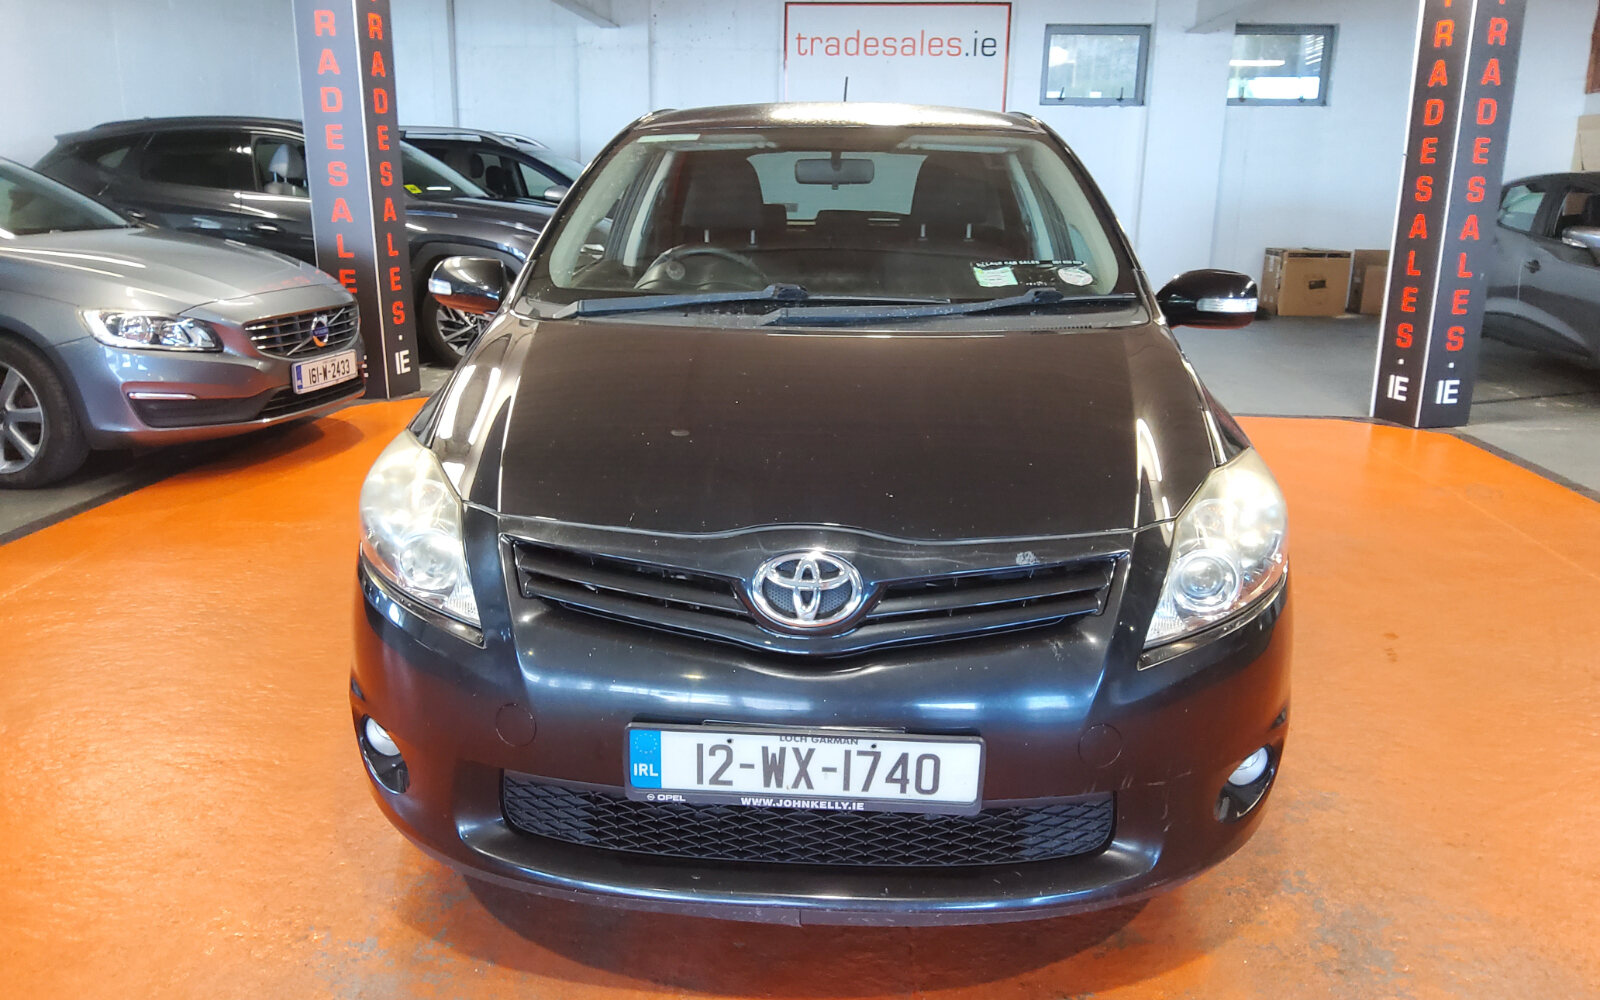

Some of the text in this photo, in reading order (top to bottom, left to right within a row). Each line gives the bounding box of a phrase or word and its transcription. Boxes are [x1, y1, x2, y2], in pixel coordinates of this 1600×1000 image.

[795, 29, 997, 57] tradesales.ie
[367, 0, 411, 375] RADESALES.IE
[1435, 0, 1508, 404] RADESALES.IE
[308, 359, 351, 385] 161-W-2433
[779, 735, 859, 745] LOCH GARMAN
[633, 763, 659, 777] IRL
[696, 743, 941, 795] 12-WX-1740
[657, 794, 686, 802] OPEL
[740, 797, 865, 811] WWW.JOHNKELLY.IE
